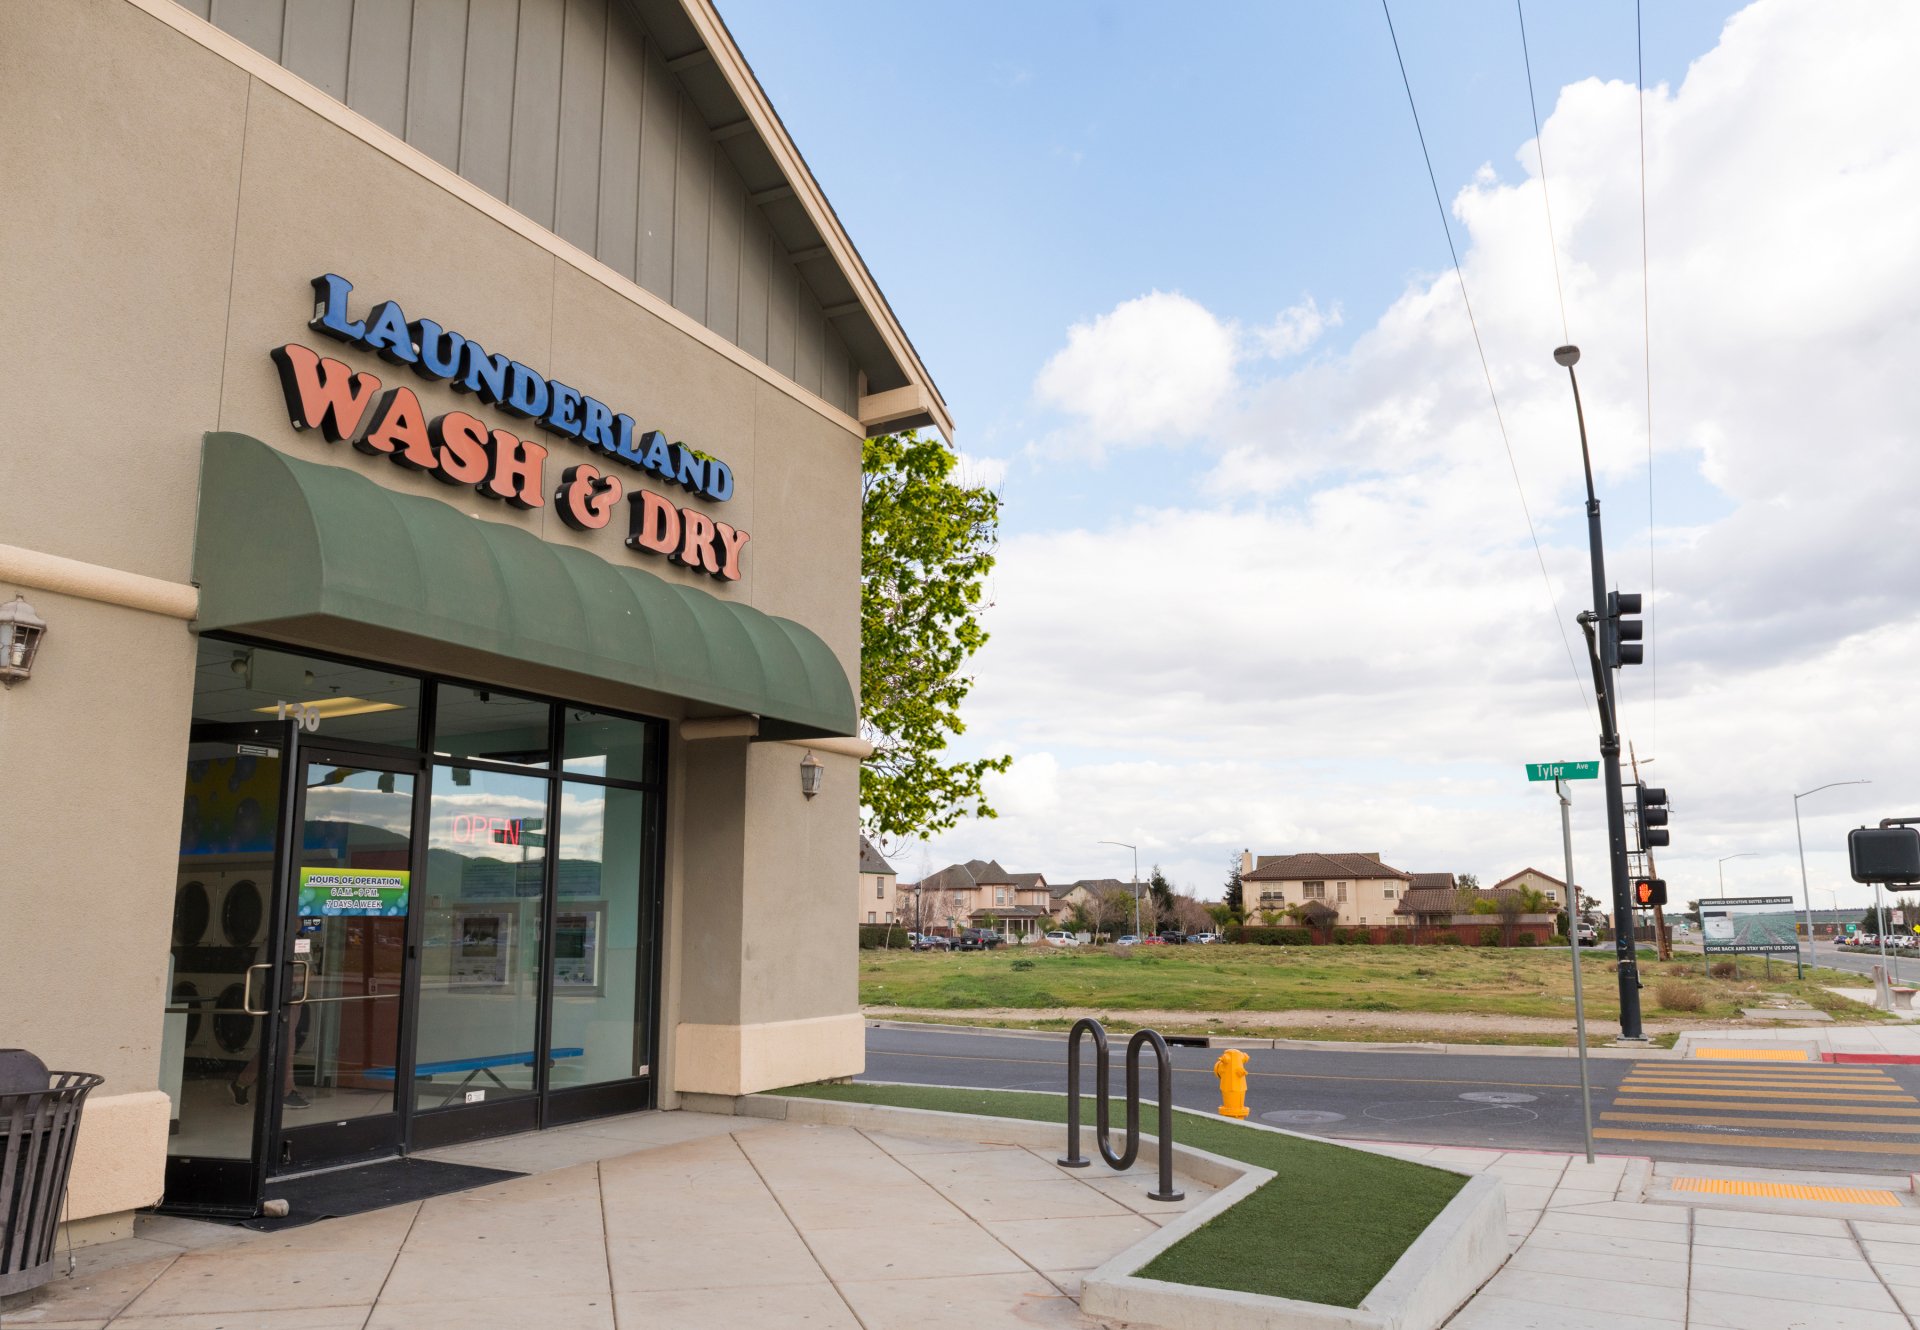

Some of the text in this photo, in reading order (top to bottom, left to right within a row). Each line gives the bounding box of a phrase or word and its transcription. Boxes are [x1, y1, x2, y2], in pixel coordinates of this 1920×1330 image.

[310, 273, 733, 501] LAUNDERLAND
[273, 343, 750, 581] WASH & DRY
[1537, 765, 1564, 780] Tyler
[453, 815, 520, 847] OPEN
[309, 875, 401, 886] HOURS OF OPERATION
[331, 888, 338, 897] 6
[326, 900, 382, 909] 7 DAYS A WEEK
